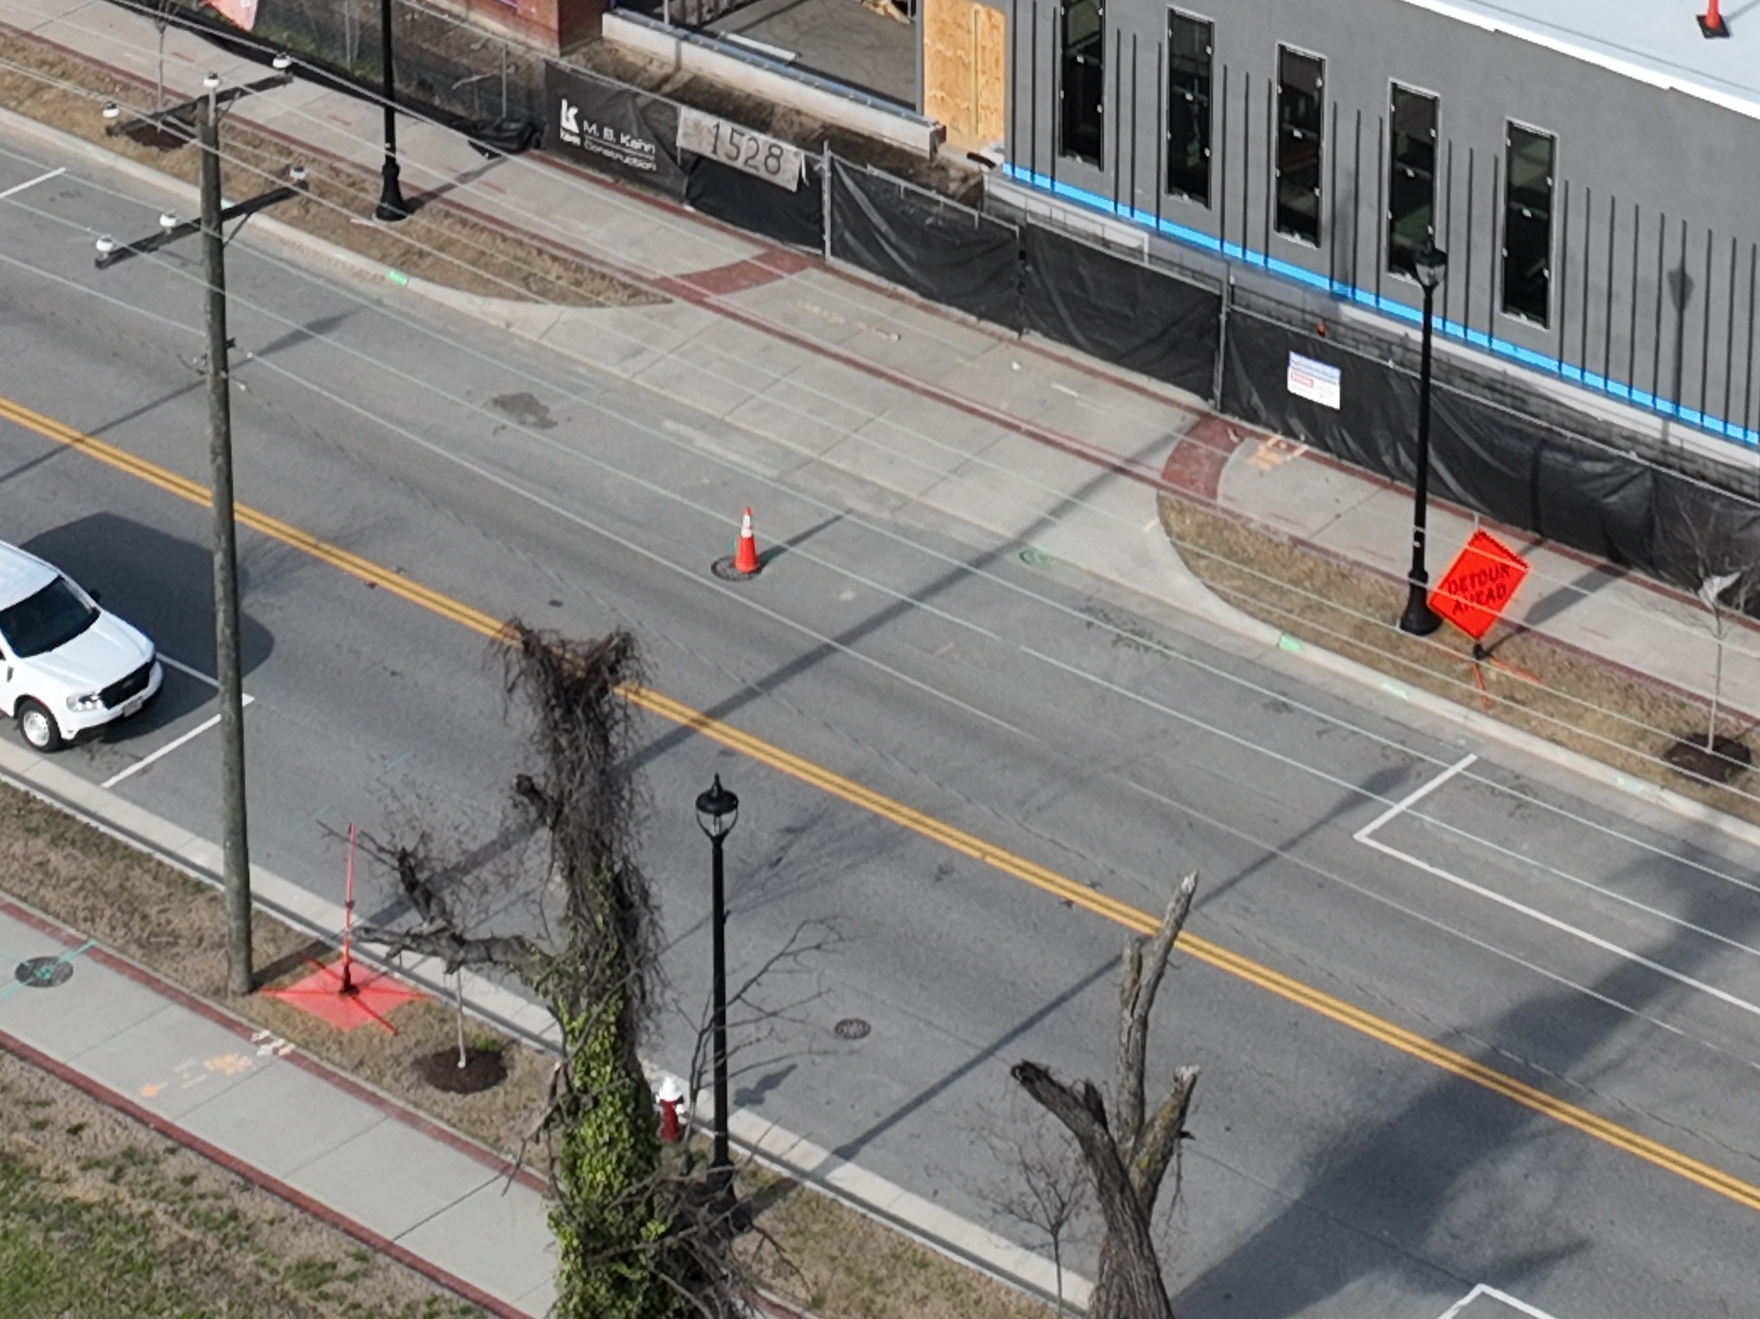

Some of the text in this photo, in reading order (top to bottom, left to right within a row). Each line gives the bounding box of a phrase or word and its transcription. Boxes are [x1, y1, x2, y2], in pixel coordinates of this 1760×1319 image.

[710, 120, 785, 176] 1528
[1447, 563, 1510, 596] DETOUR
[1452, 582, 1507, 616] AHEAD
